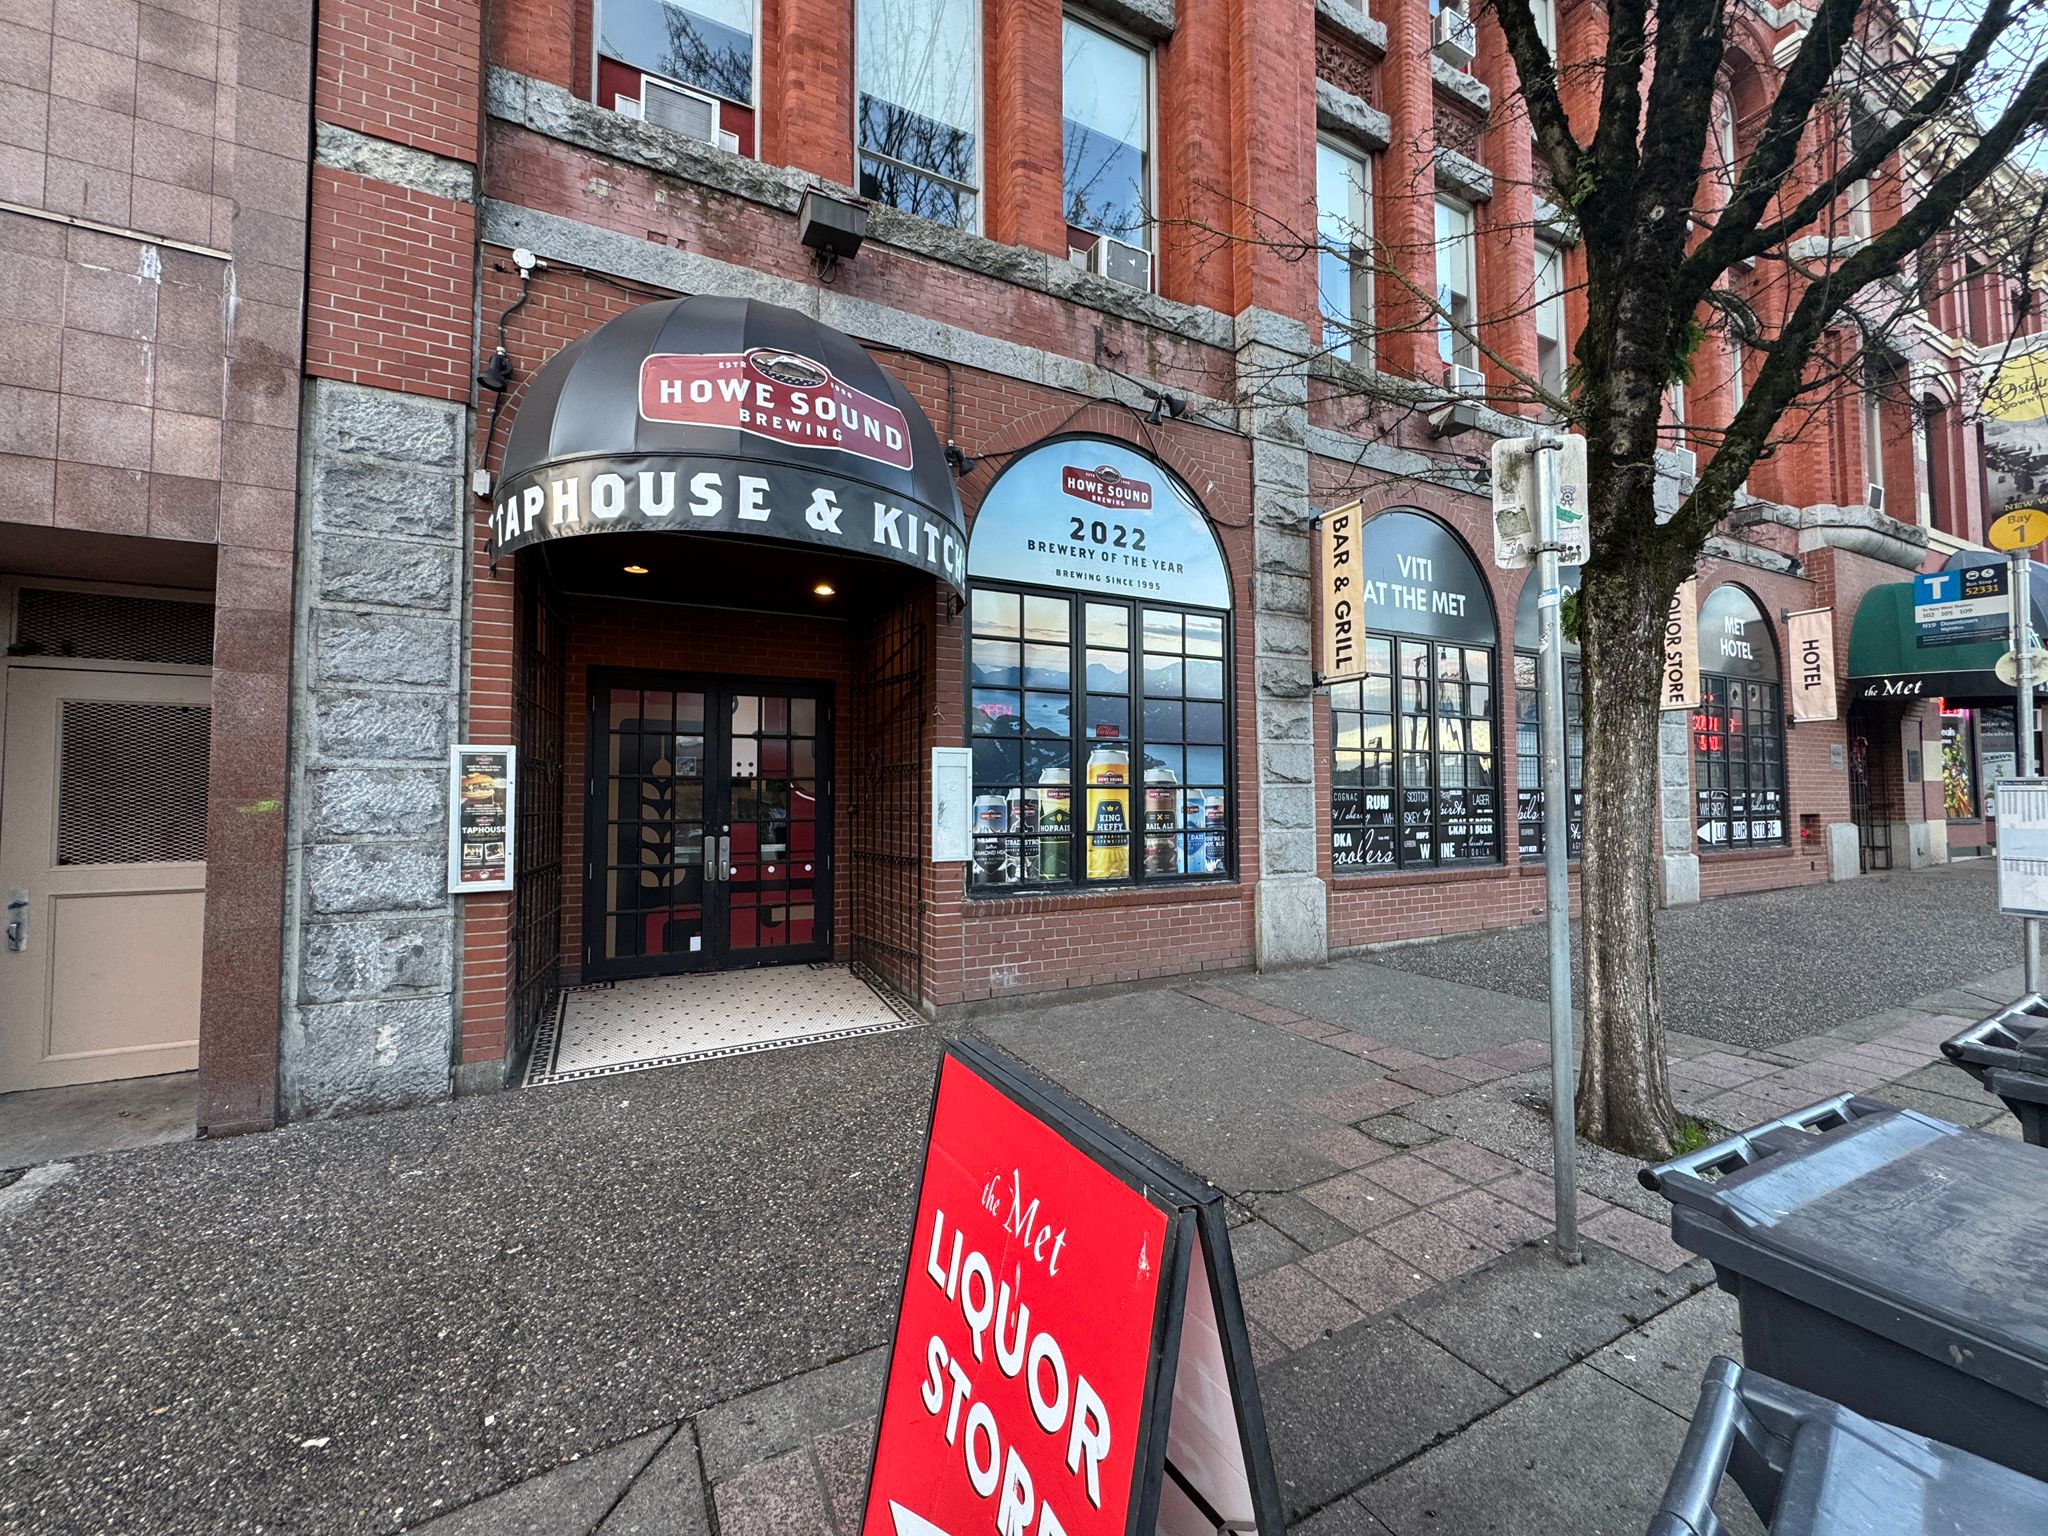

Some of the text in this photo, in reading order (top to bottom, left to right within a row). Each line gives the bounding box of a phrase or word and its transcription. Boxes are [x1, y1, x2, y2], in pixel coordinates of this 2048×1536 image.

[660, 378, 903, 451] HOWE SOUND
[739, 408, 843, 442] BREWING
[1067, 477, 1149, 503] HOWE SOUND
[1091, 495, 1126, 507] BREWING
[2004, 500, 2034, 511] NEW
[495, 471, 966, 590] TAPHOUSE & KITCH
[2007, 514, 2032, 525] Bay
[1070, 517, 1147, 551] 2022
[2012, 524, 2025, 543] 1
[1027, 539, 1185, 575] BREWERY OF THE YEAR
[1396, 553, 1433, 582] VITI
[1055, 568, 1161, 591] BREWING SINCE 1995
[1923, 575, 1950, 600] T
[1965, 584, 1999, 596] 52331
[1332, 514, 1353, 669] BAR & GRILL
[1363, 579, 1466, 617] AT THE MET
[1724, 615, 1745, 637] MET
[1720, 637, 1754, 660] HOTEL
[1802, 638, 1822, 691] HOTEL
[1667, 652, 1685, 703] STORE
[1864, 678, 1923, 697] the Met
[1333, 791, 1490, 810] COGNAC RUM SCOTCH LAGER
[1097, 823, 1123, 831] HEFFY
[1099, 814, 1121, 822] KING
[1475, 818, 1493, 835] BEER
[1753, 822, 1776, 837] STORE
[462, 826, 507, 834] TAPHOUSE
[982, 1168, 1067, 1277] the Met
[927, 1208, 1111, 1510] LIQUOR
